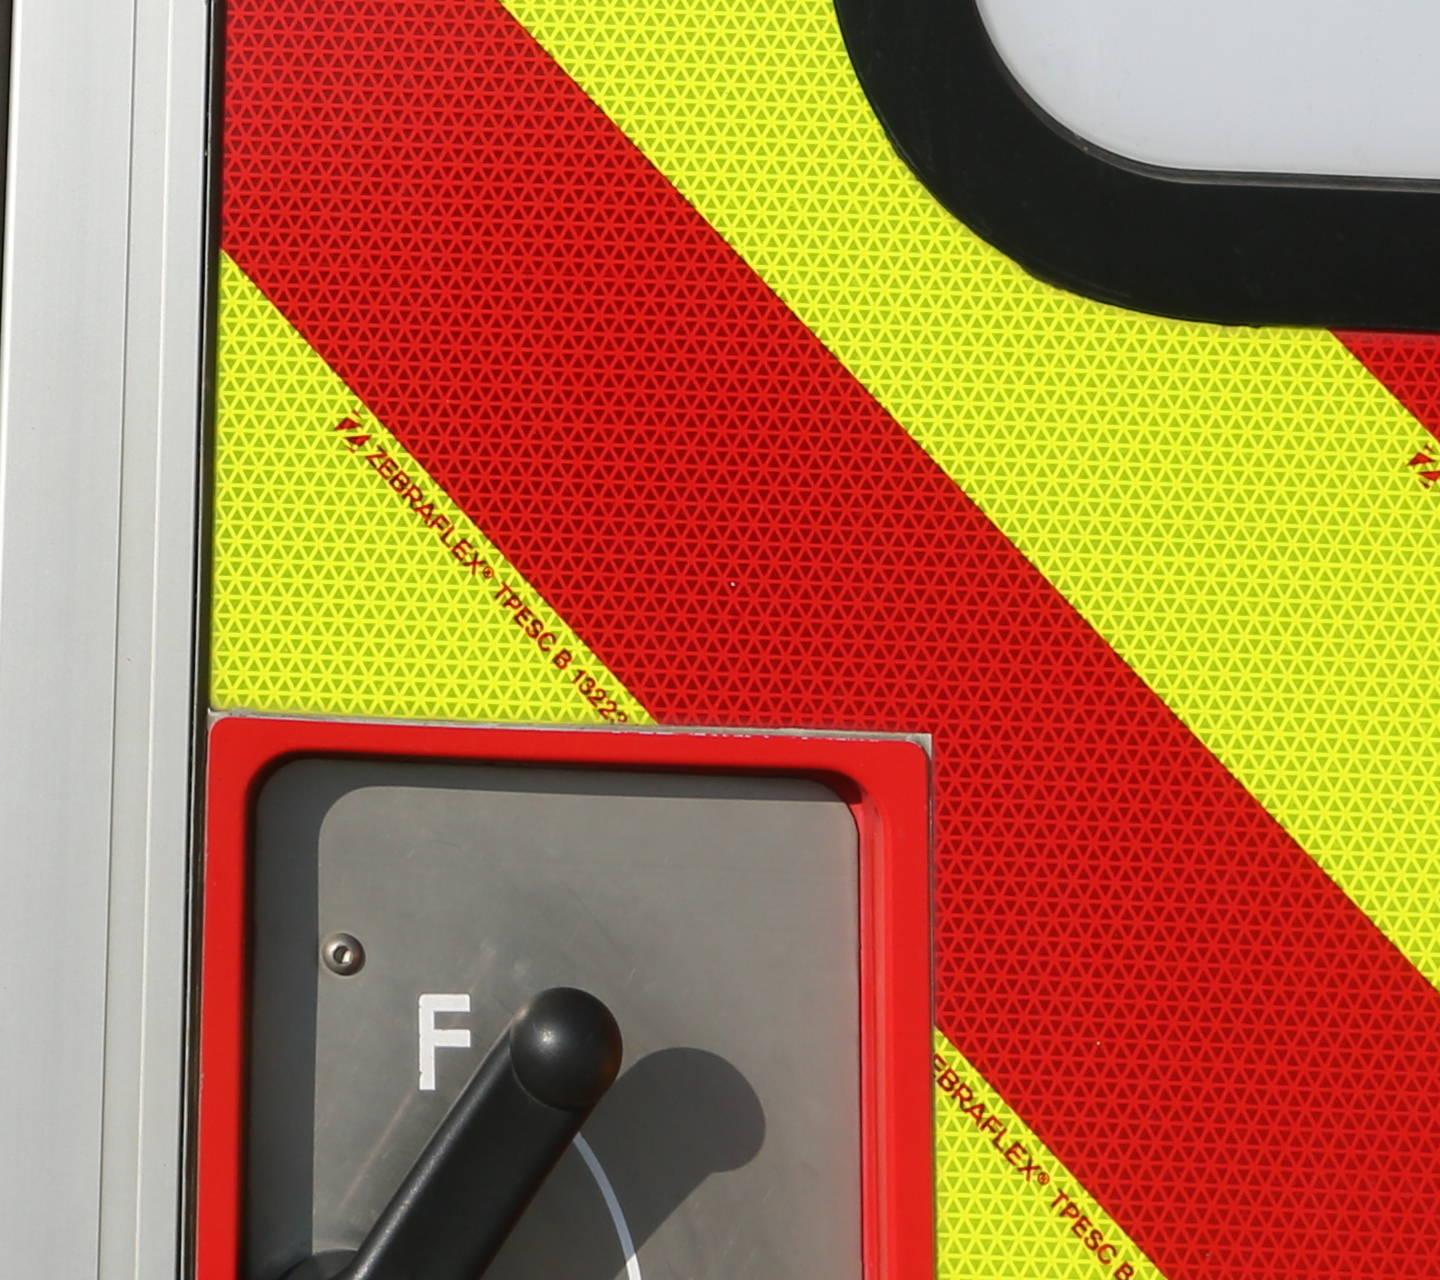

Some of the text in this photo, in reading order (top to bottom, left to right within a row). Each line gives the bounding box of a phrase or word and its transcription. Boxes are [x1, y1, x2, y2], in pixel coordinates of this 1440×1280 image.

[494, 582, 558, 653] TPESC
[552, 648, 574, 672] B
[418, 993, 471, 1091] F
[1050, 1190, 1137, 1280] TPESC B
